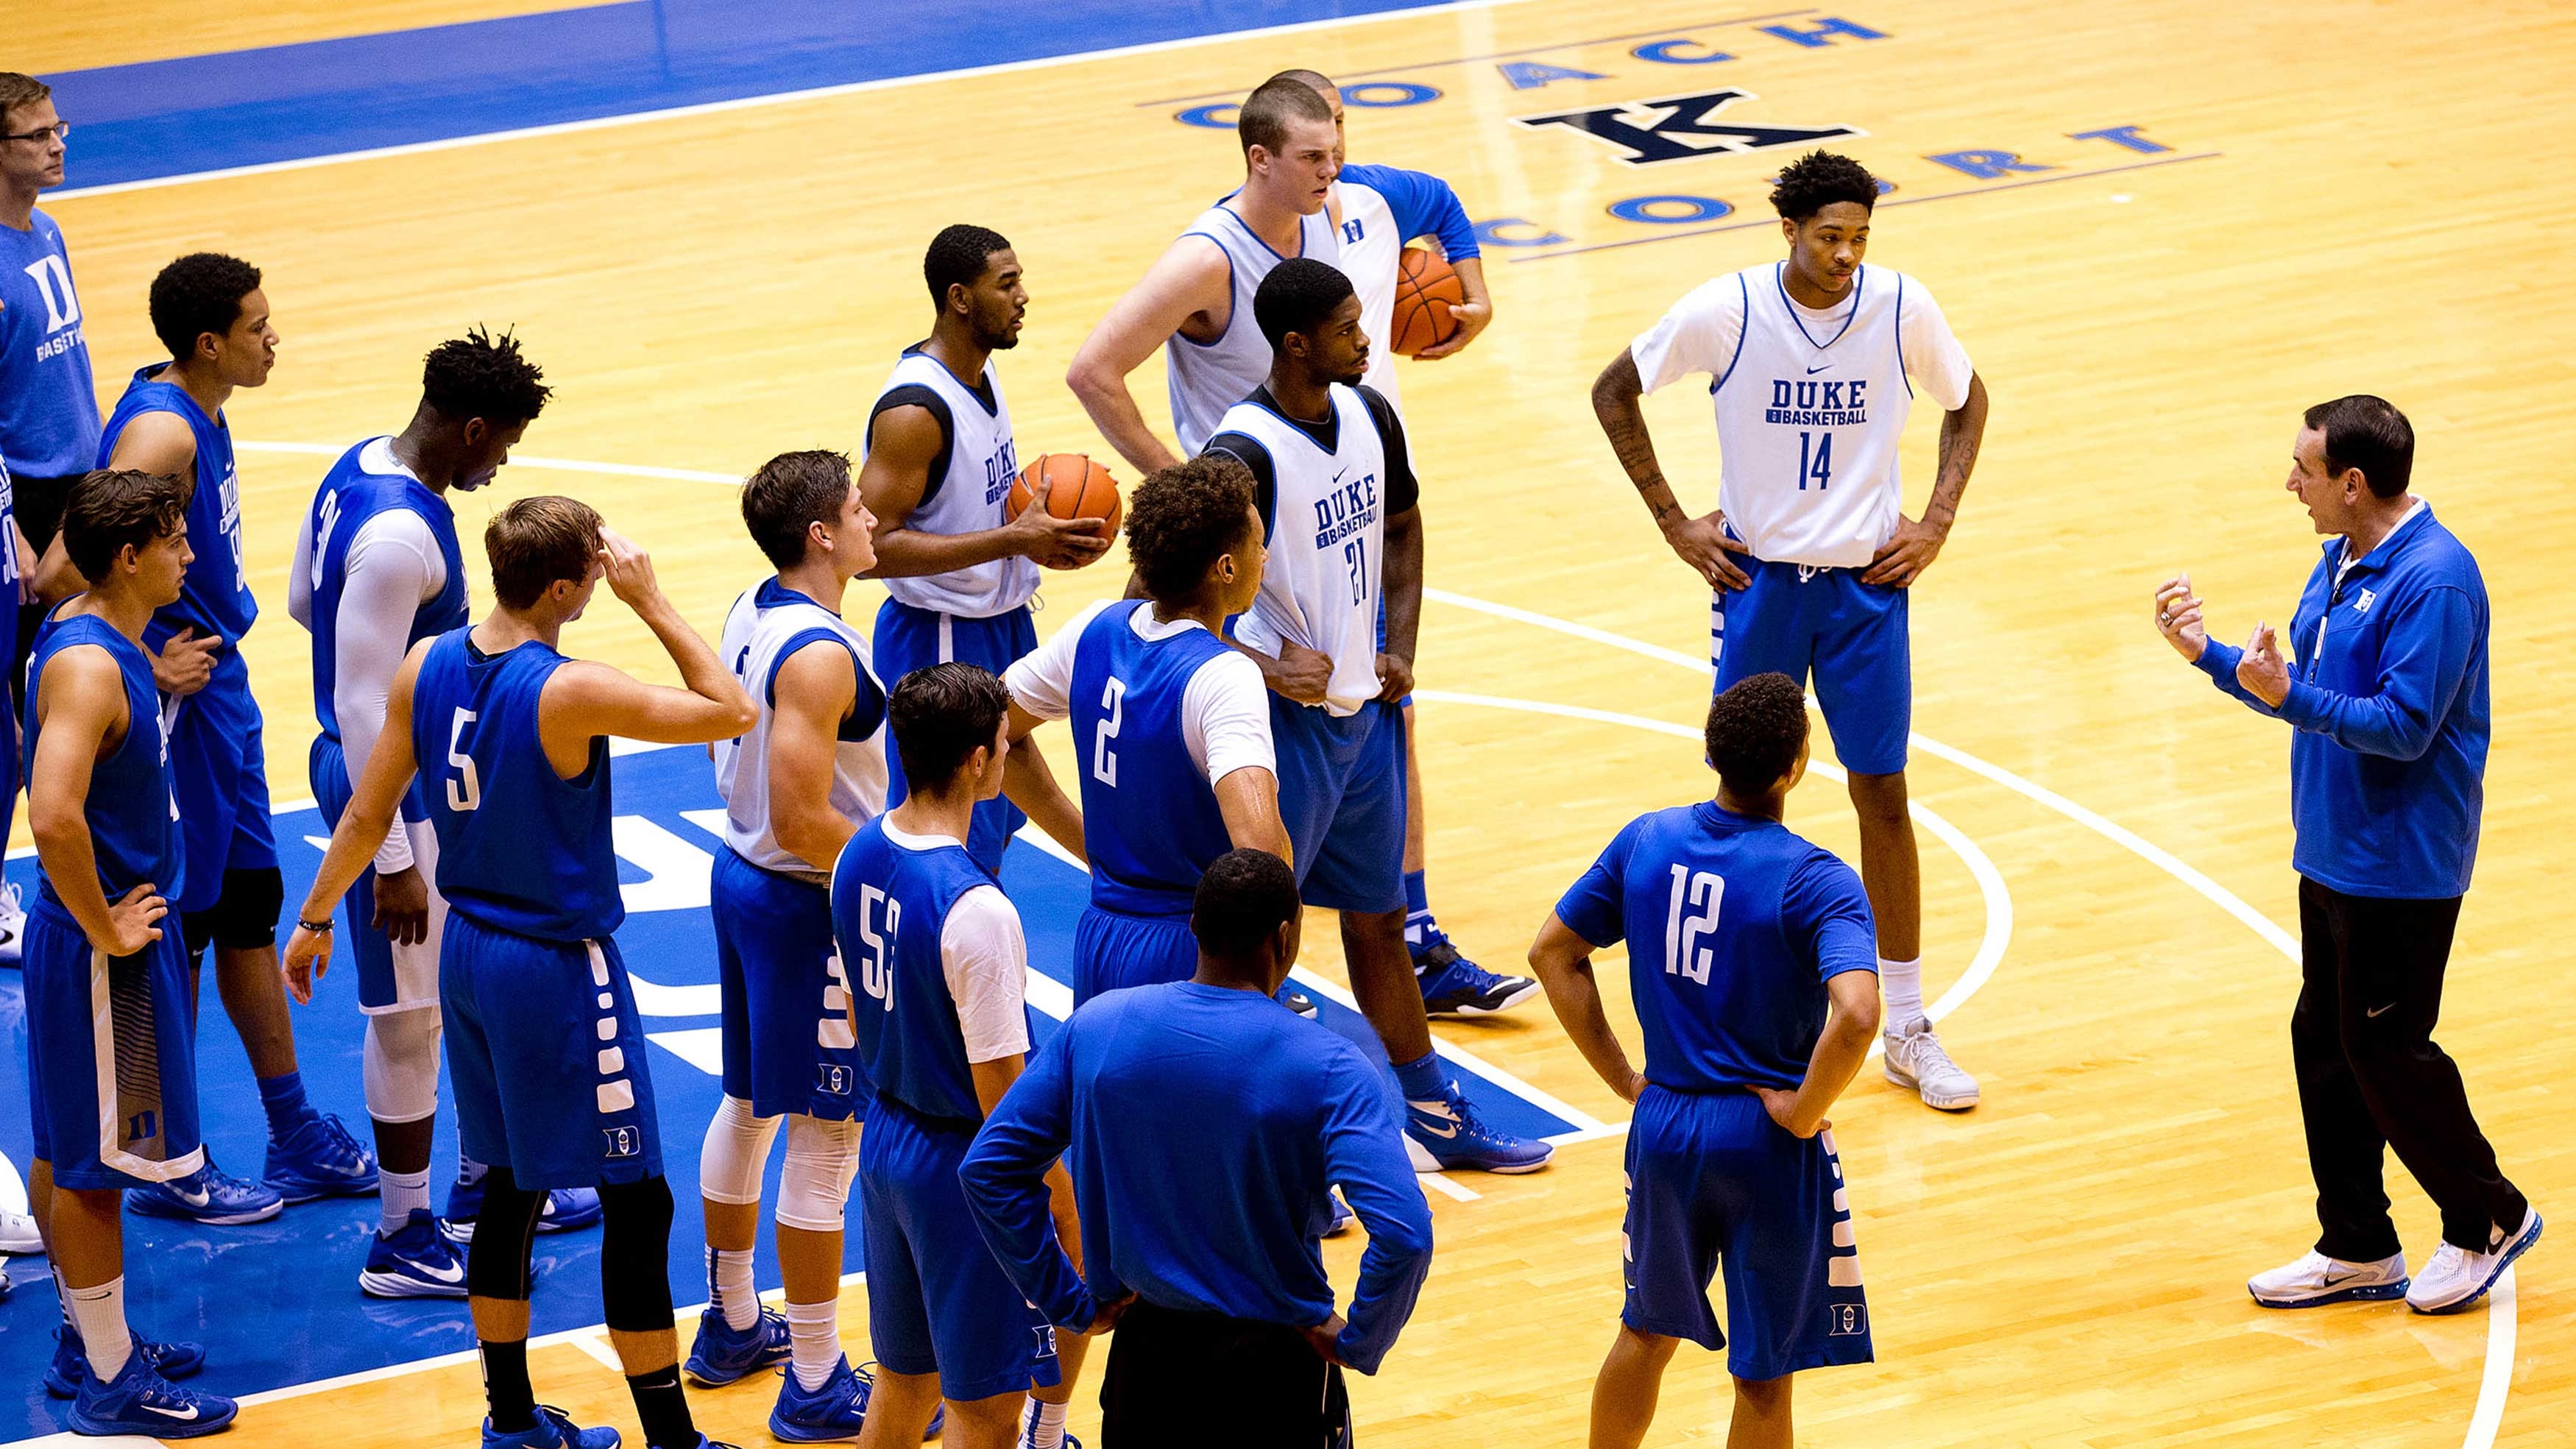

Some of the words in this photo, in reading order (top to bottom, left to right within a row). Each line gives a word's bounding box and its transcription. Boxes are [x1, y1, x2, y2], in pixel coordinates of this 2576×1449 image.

[1174, 14, 1892, 130] COACH
[1511, 85, 1871, 168] K
[1472, 124, 2176, 248] CORT
[24, 254, 79, 335] D
[1772, 379, 1867, 410] DUKE
[1783, 408, 1867, 426] BASKETBALL
[1314, 473, 1377, 531] DUKE
[1798, 431, 1833, 491] 14
[1344, 536, 1367, 607] 21
[446, 706, 481, 812] 5
[1094, 675, 1127, 788] 2
[1666, 862, 1725, 986] 12
